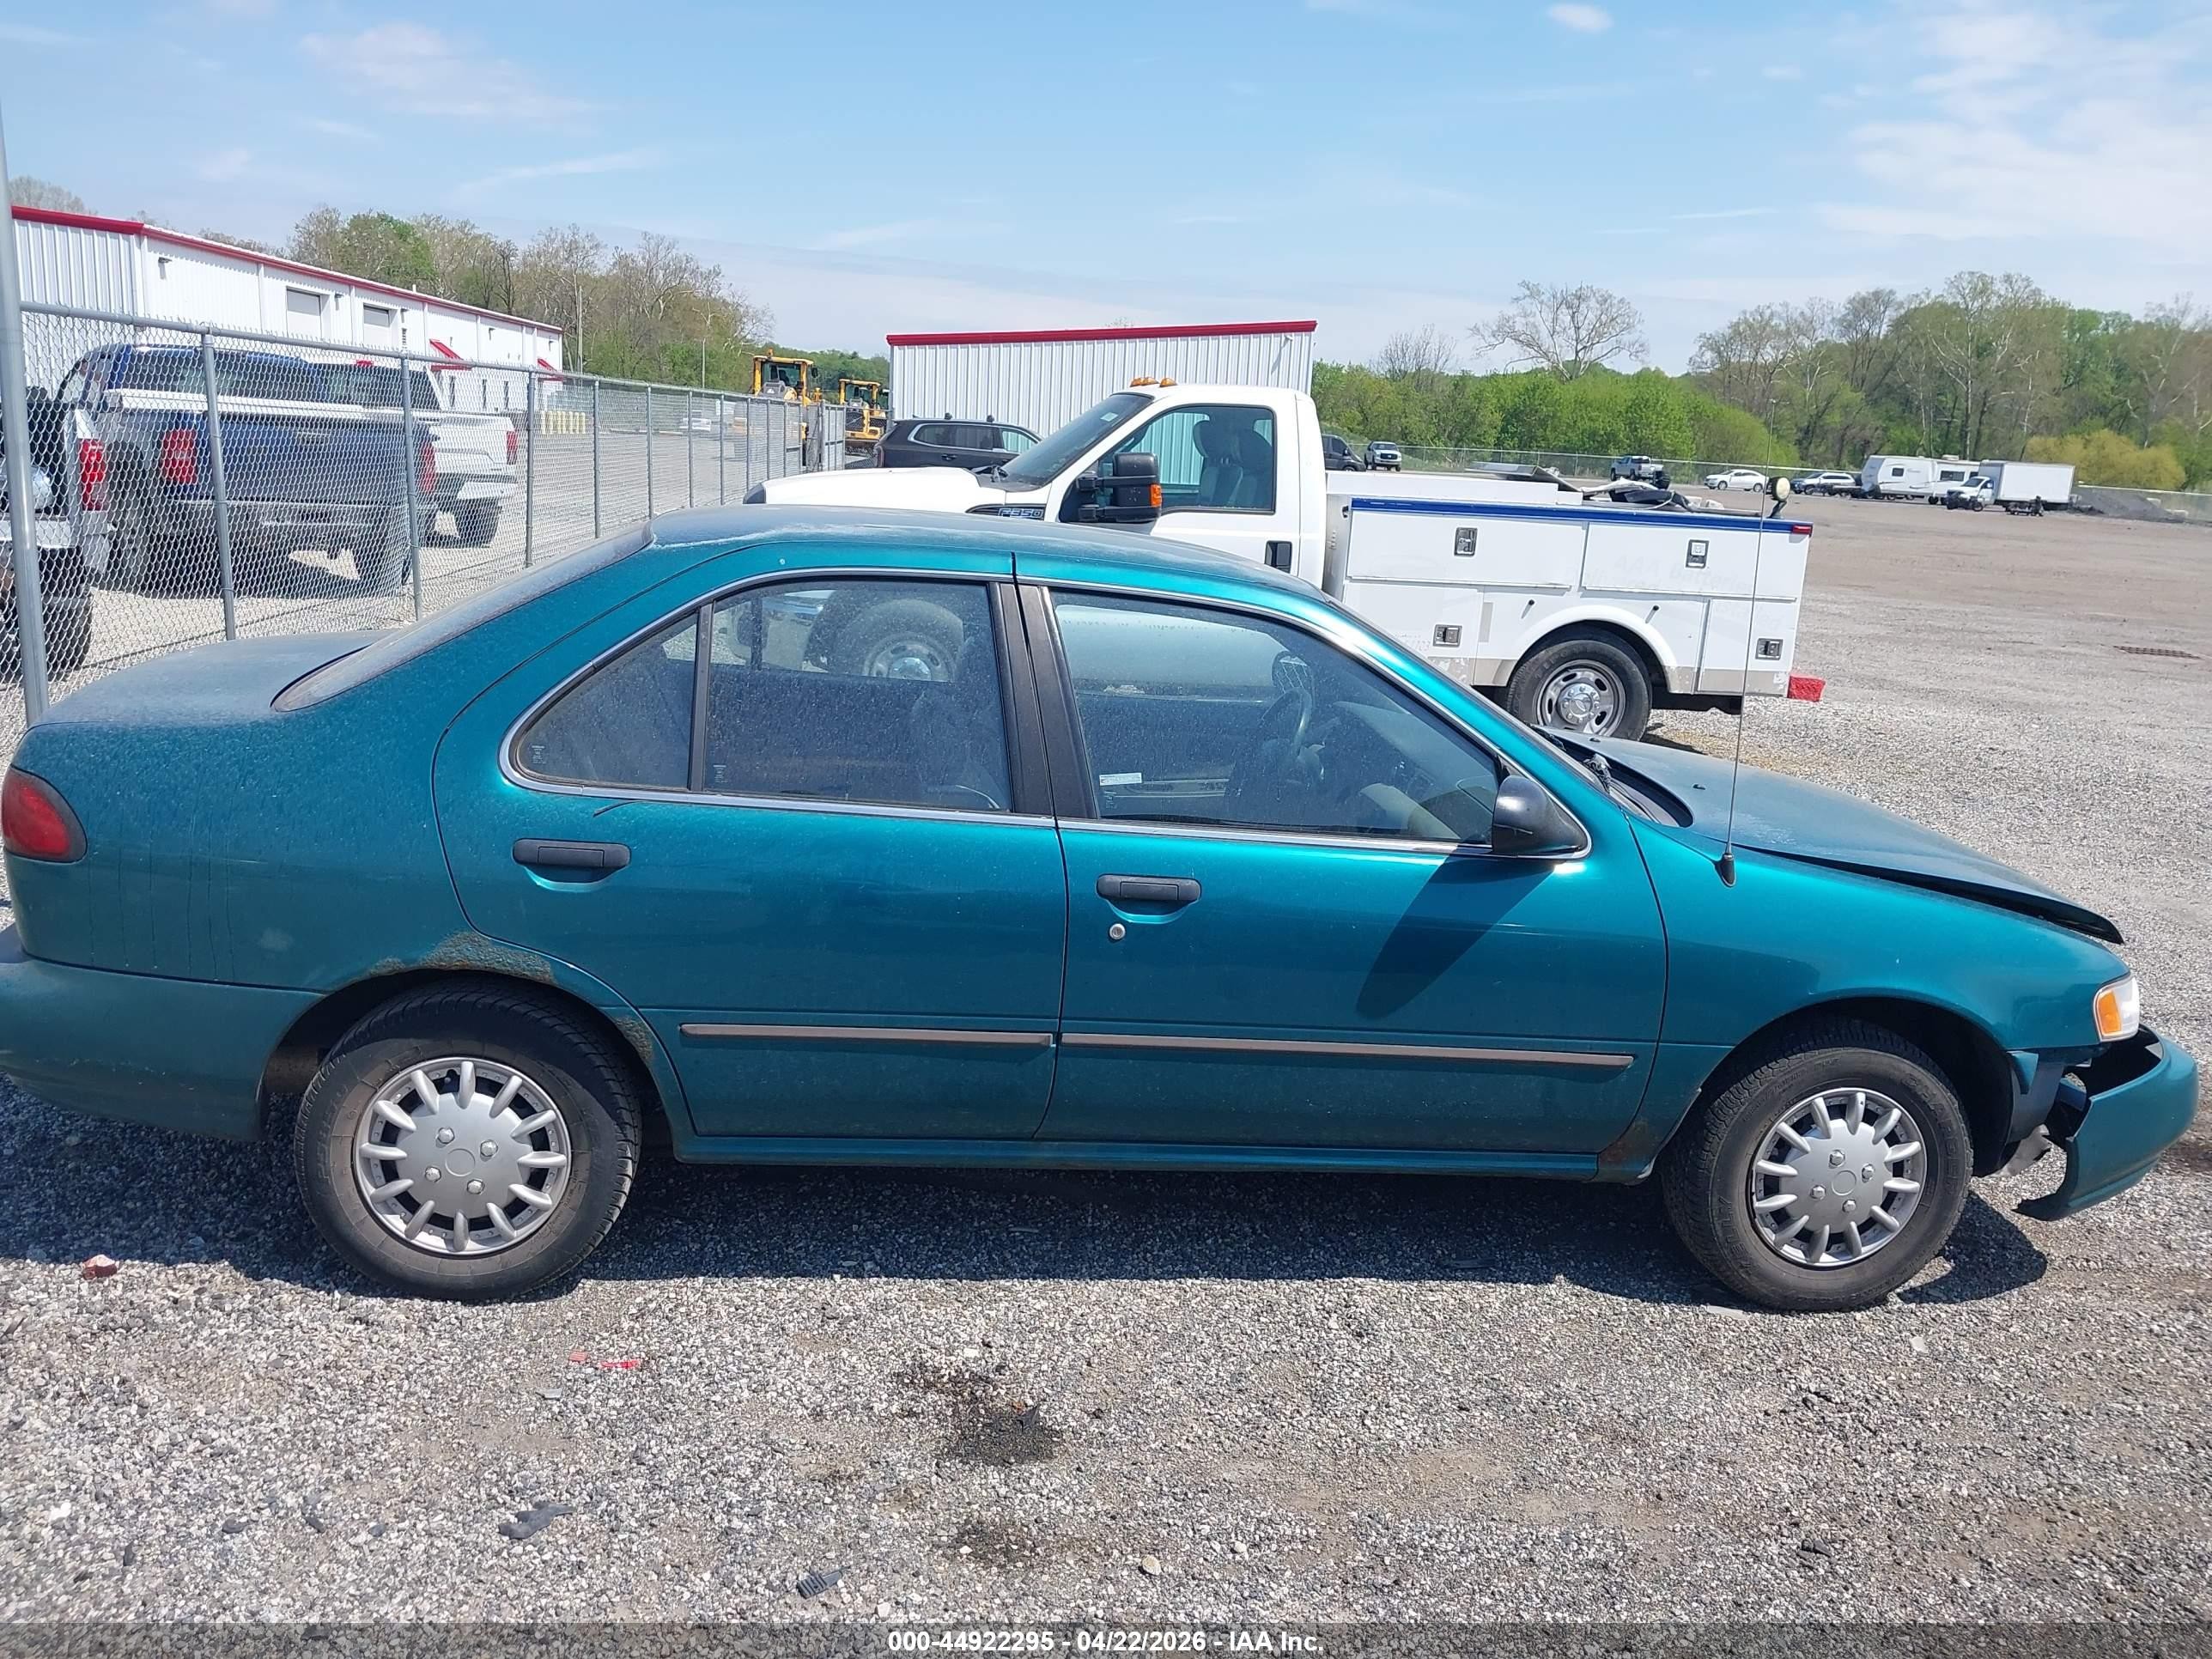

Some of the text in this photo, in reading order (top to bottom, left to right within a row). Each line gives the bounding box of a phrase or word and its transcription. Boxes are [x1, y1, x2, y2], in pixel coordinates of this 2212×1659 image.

[998, 507, 1043, 518] F350
[1613, 554, 1662, 579] AAA
[1717, 1194, 1758, 1277] KELLY
